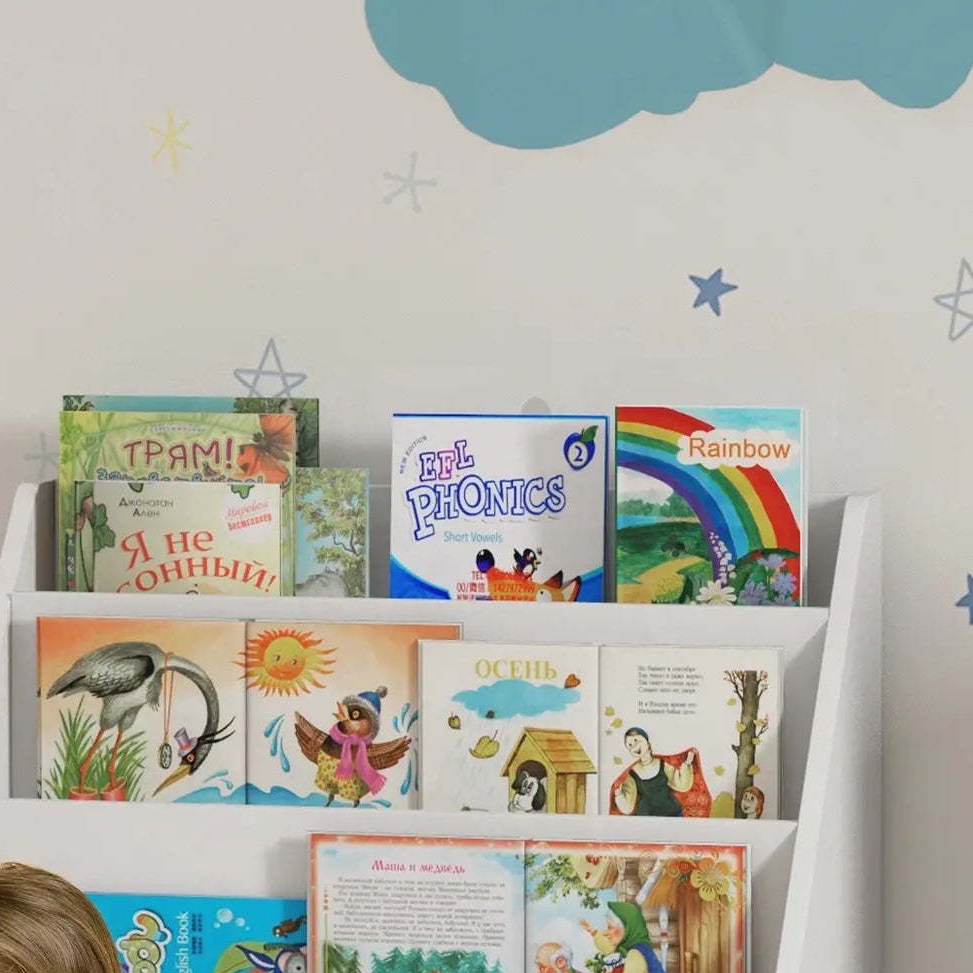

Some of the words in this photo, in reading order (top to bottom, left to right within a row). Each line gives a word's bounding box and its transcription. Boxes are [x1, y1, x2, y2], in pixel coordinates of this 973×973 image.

[123, 437, 232, 470] ТРЯМ!
[419, 440, 475, 482] EFL
[572, 446, 584, 463] 2
[688, 437, 791, 460] Rainbow
[407, 474, 567, 541] PHONICS
[120, 530, 153, 570] Я
[164, 530, 214, 555] не
[444, 530, 468, 543] Short
[470, 530, 503, 543] Vowels
[475, 657, 558, 682] ОСЕНЬ
[371, 860, 406, 872] Маша
[409, 864, 417, 872] и
[420, 864, 466, 874] медведь
[176, 911, 189, 946] Book
